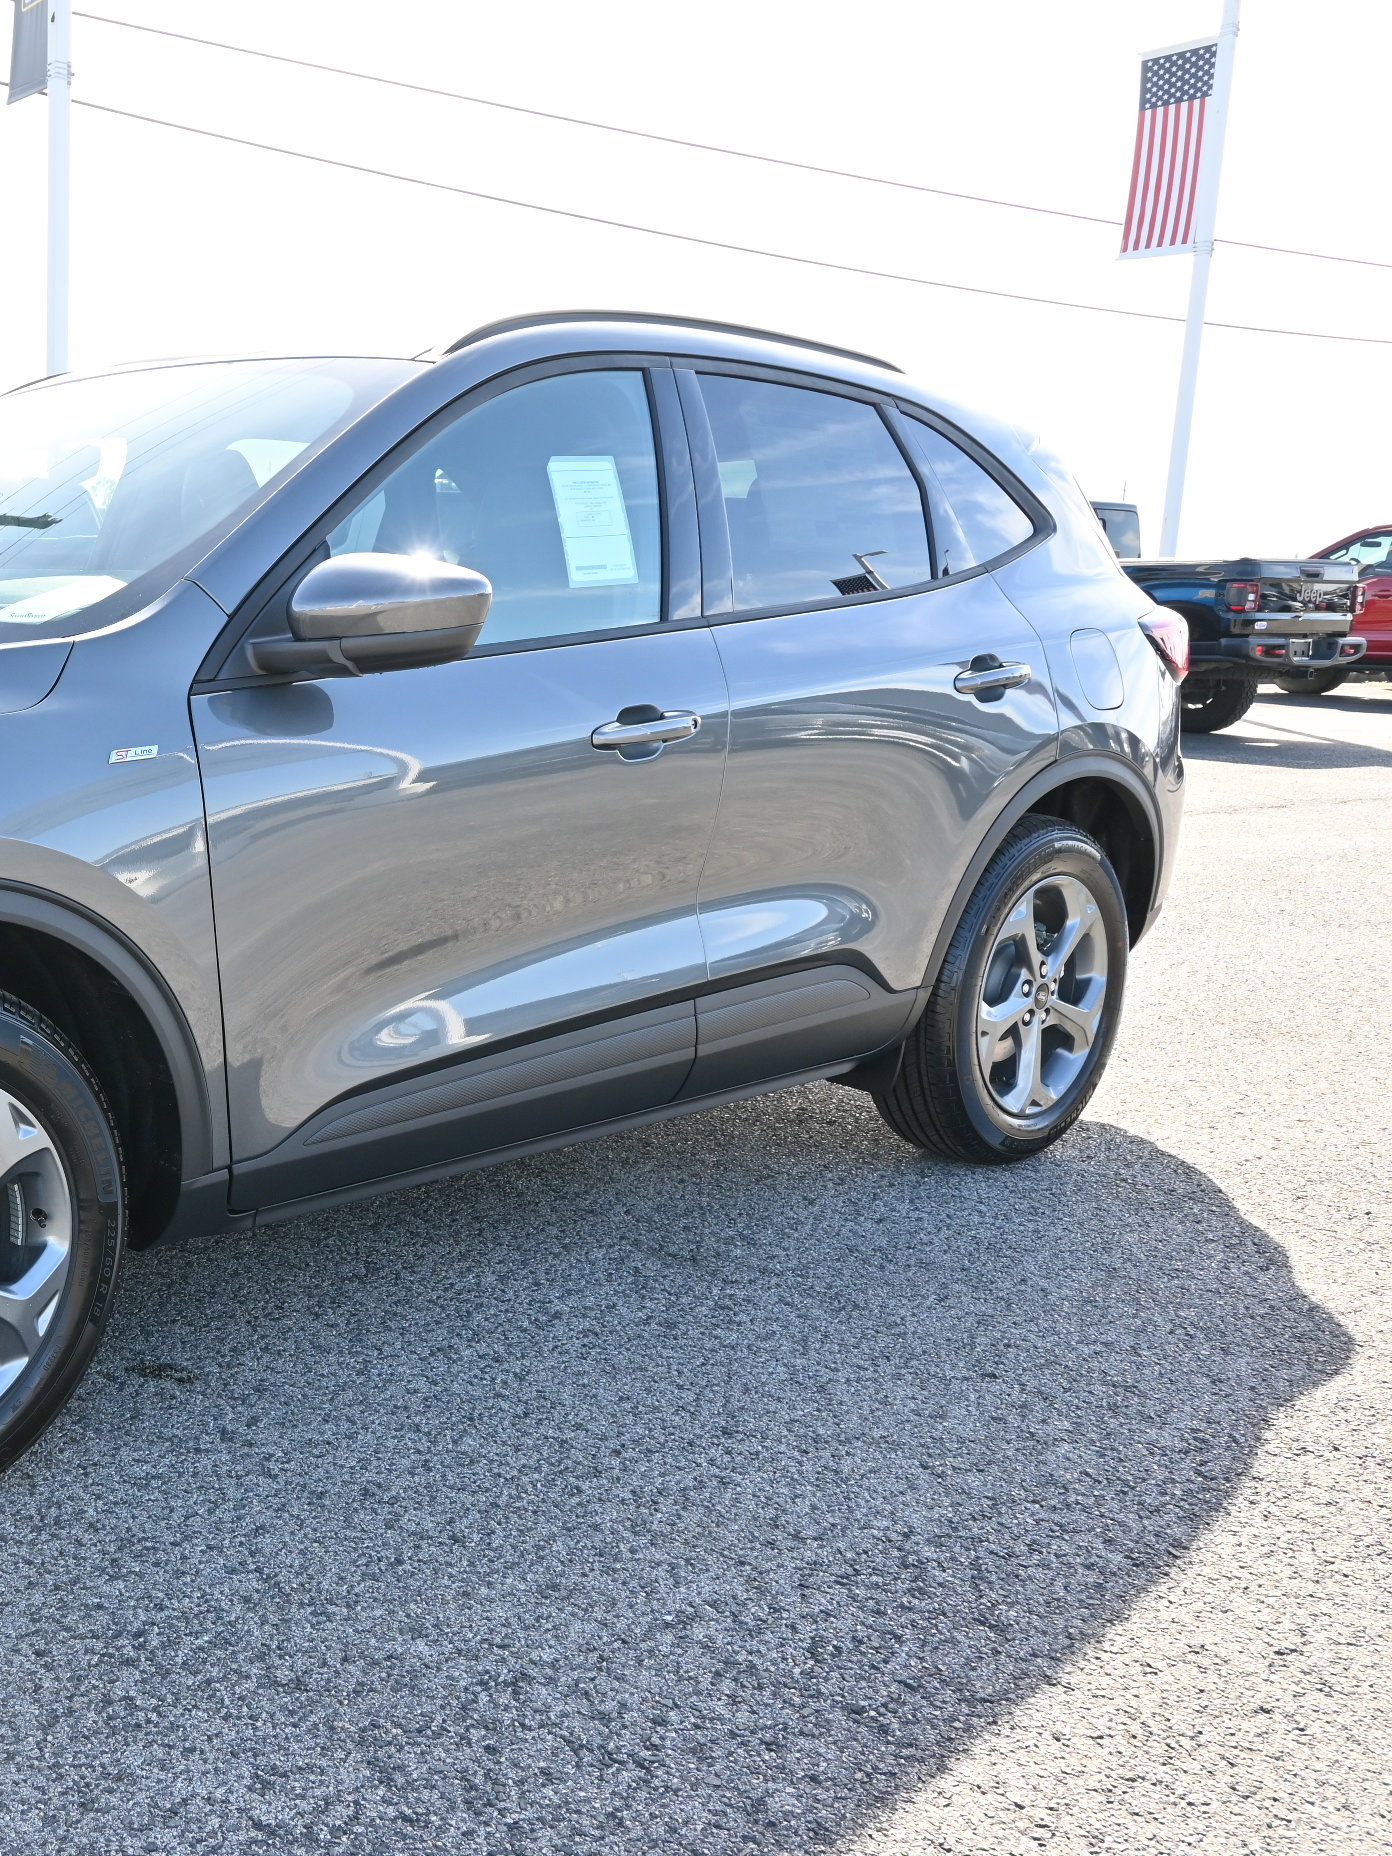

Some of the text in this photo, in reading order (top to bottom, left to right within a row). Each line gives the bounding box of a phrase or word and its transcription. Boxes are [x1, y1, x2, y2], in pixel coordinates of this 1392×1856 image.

[1296, 585, 1324, 605] Jeep
[115, 749, 132, 761] ST
[59, 1080, 114, 1197] MICHELIN
[103, 1218, 116, 1278] 225/60
